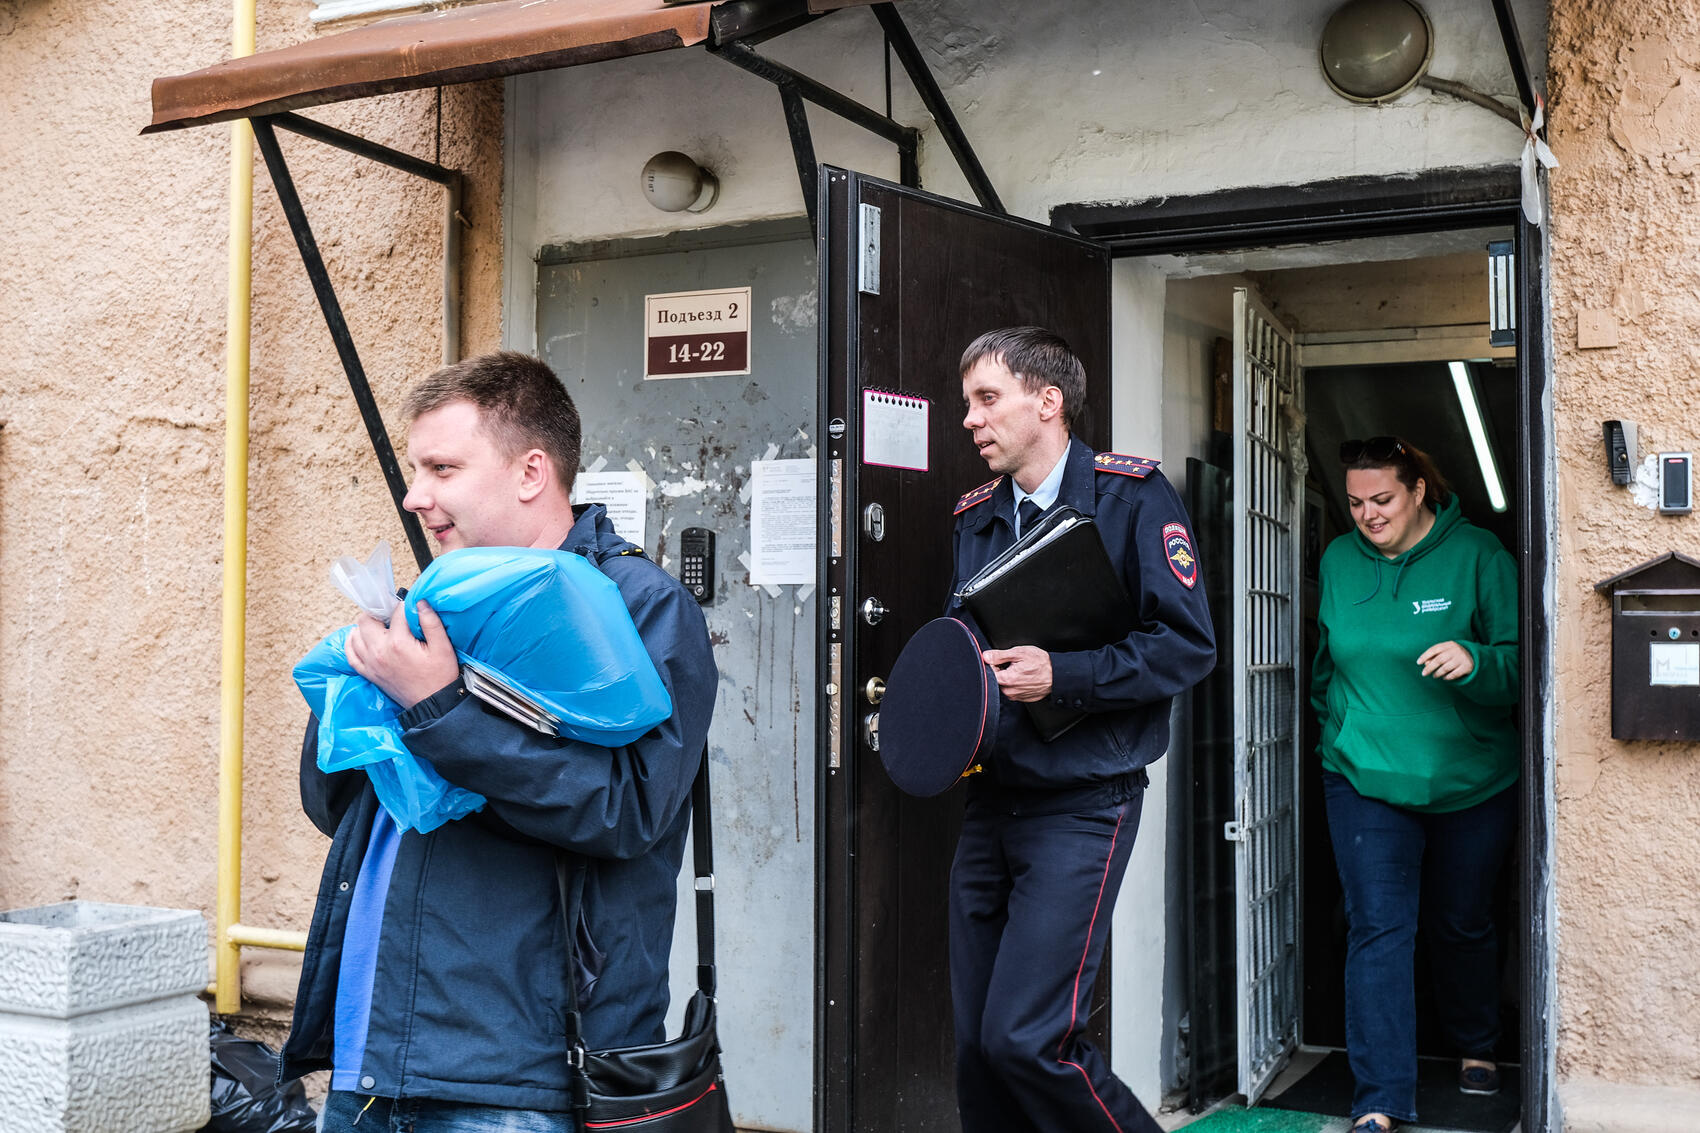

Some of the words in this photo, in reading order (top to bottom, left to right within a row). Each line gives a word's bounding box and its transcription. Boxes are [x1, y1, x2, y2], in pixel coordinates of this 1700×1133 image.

[657, 310, 722, 324] Подъезд
[728, 302, 739, 319] 2
[668, 341, 725, 363] 14-22
[1168, 538, 1190, 550] РОССИЯ
